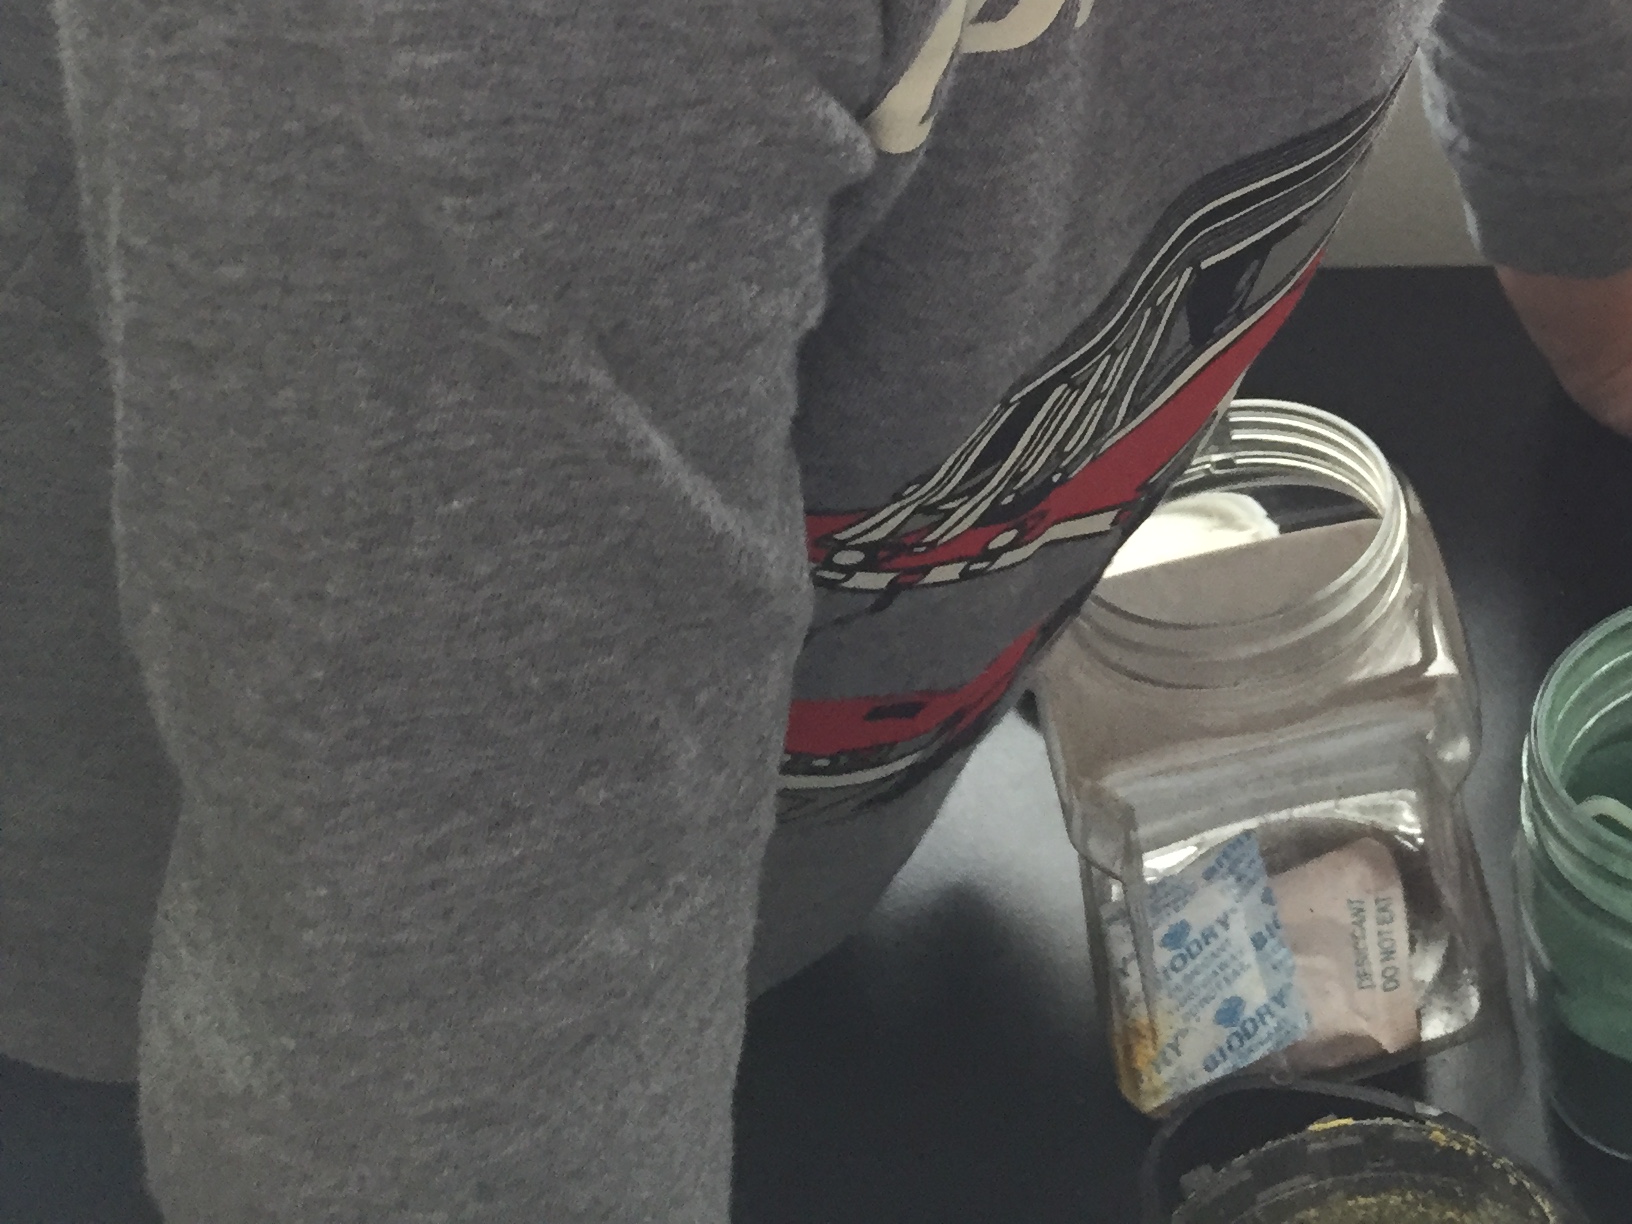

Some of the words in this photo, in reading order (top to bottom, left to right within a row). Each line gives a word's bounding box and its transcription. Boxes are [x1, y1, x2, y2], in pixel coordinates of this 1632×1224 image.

[1163, 911, 1231, 981] IODRY
[1377, 930, 1397, 963] NOT
[1381, 965, 1400, 993] DO
